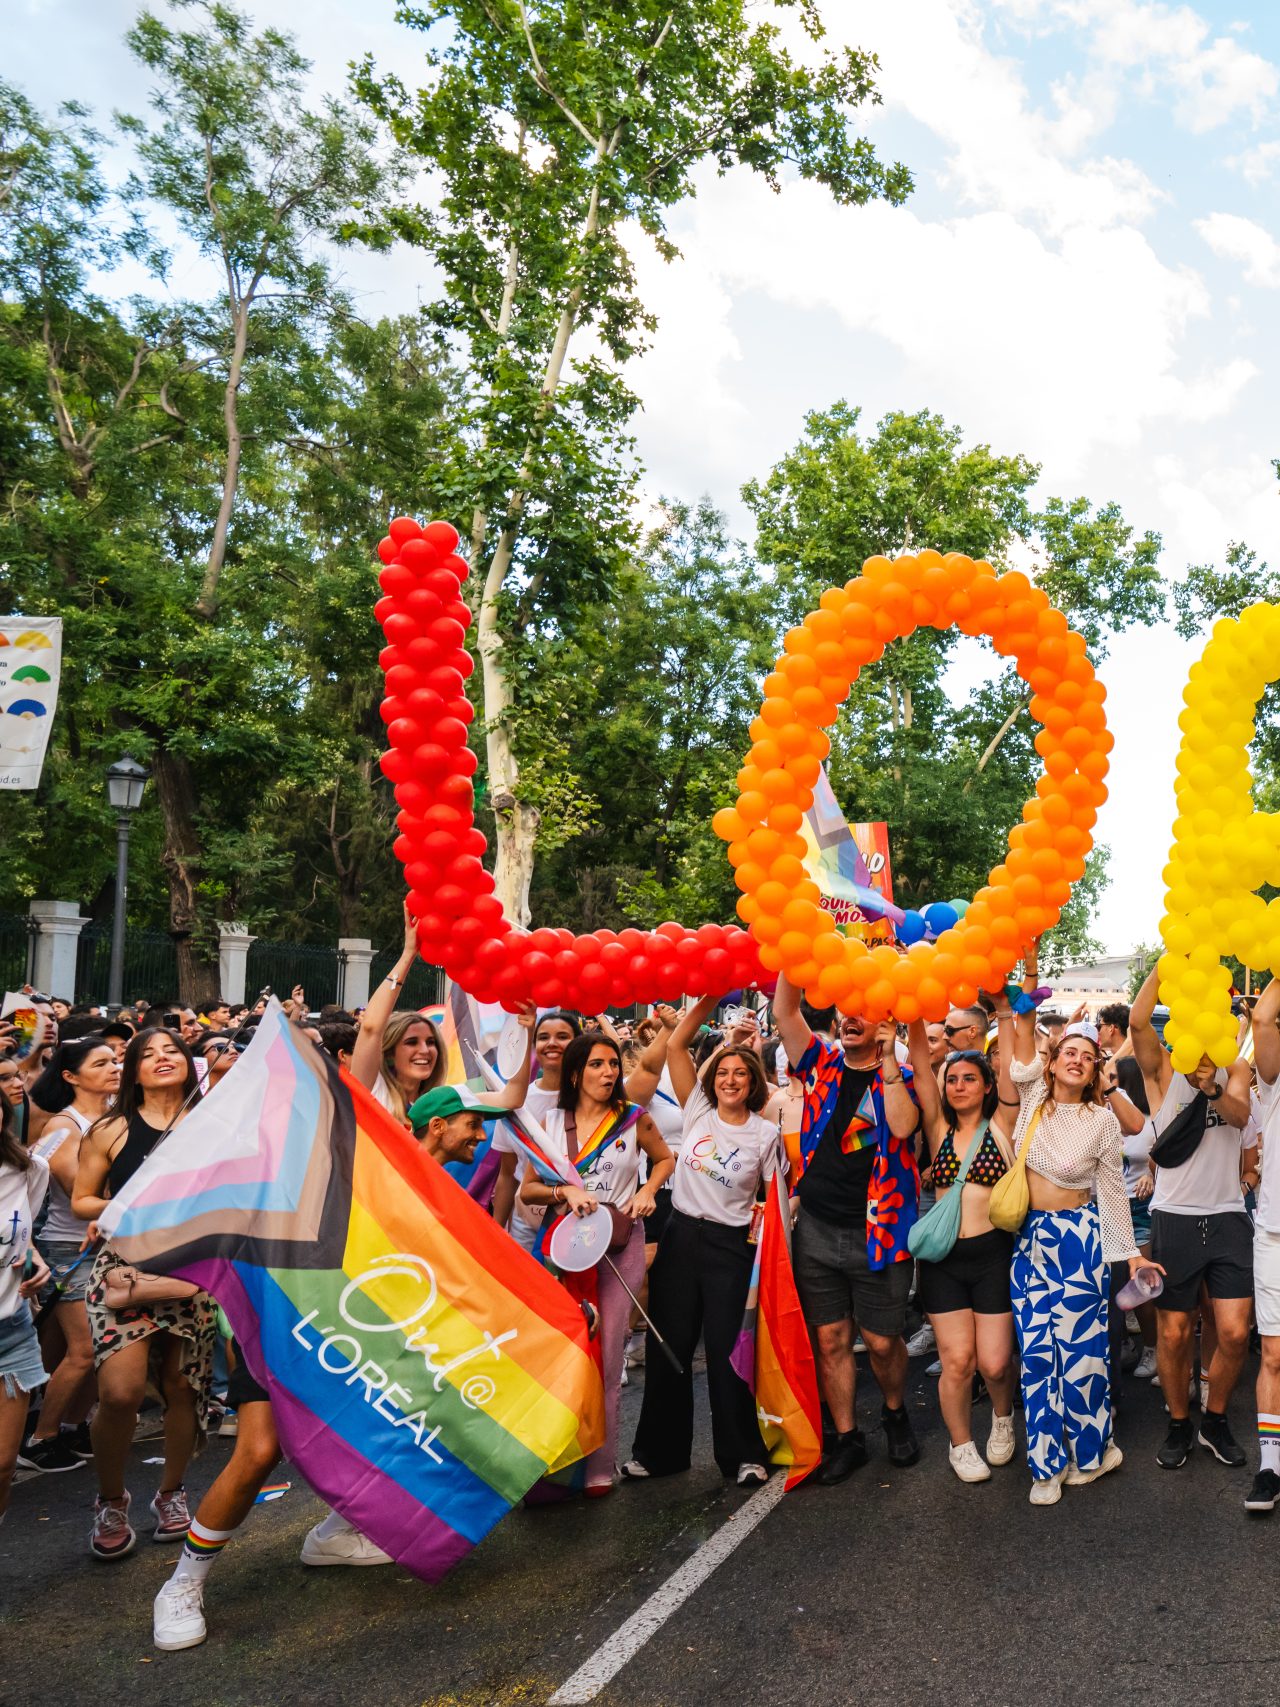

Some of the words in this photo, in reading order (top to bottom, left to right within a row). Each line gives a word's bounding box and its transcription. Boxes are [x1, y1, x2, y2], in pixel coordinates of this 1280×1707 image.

[602, 1161, 613, 1172] @
[692, 1135, 740, 1170] Out
[731, 1161, 742, 1172] @
[339, 1253, 518, 1392] Out
[460, 1375, 496, 1410] @
